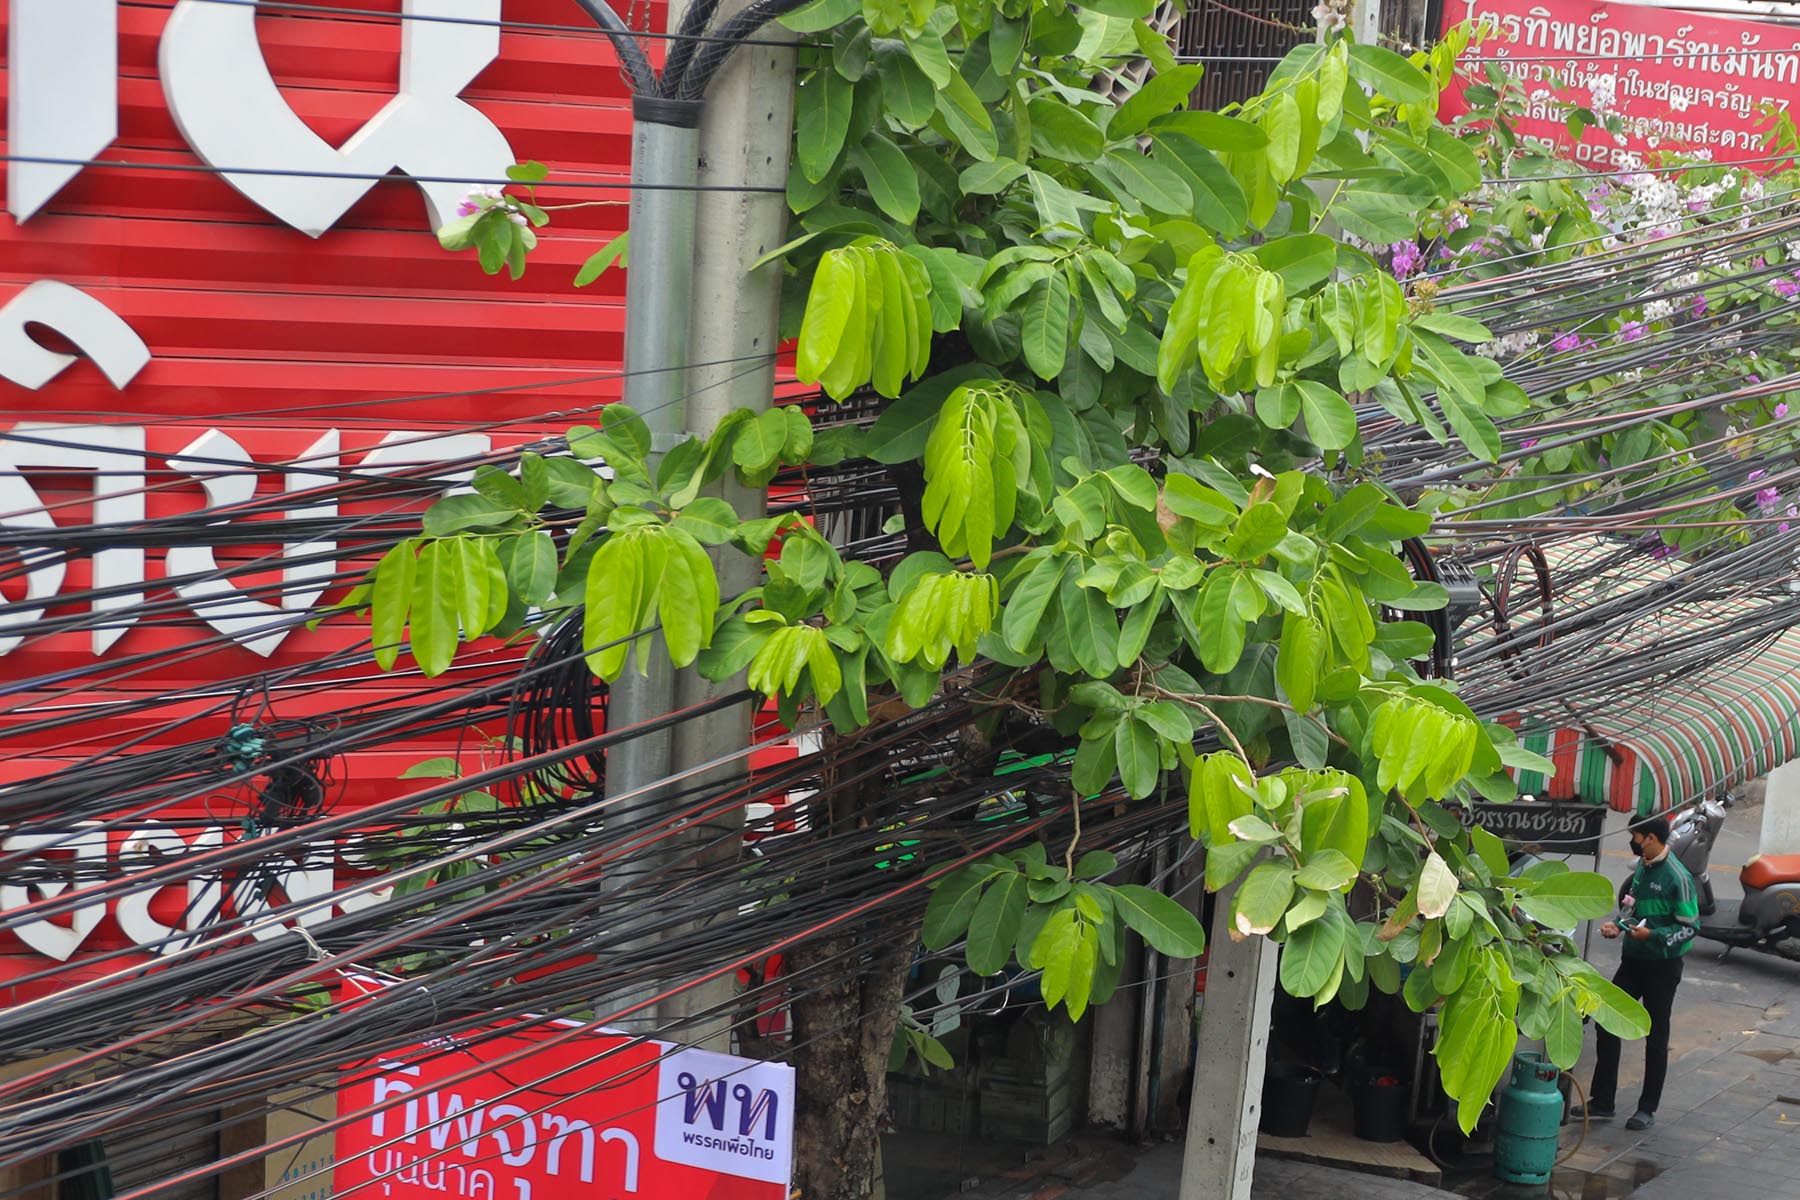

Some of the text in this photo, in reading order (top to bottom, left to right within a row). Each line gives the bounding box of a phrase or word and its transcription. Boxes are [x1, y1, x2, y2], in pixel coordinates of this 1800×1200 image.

[676, 1071, 778, 1141] พท
[682, 1127, 775, 1160] พรรคเพื่อไทย
